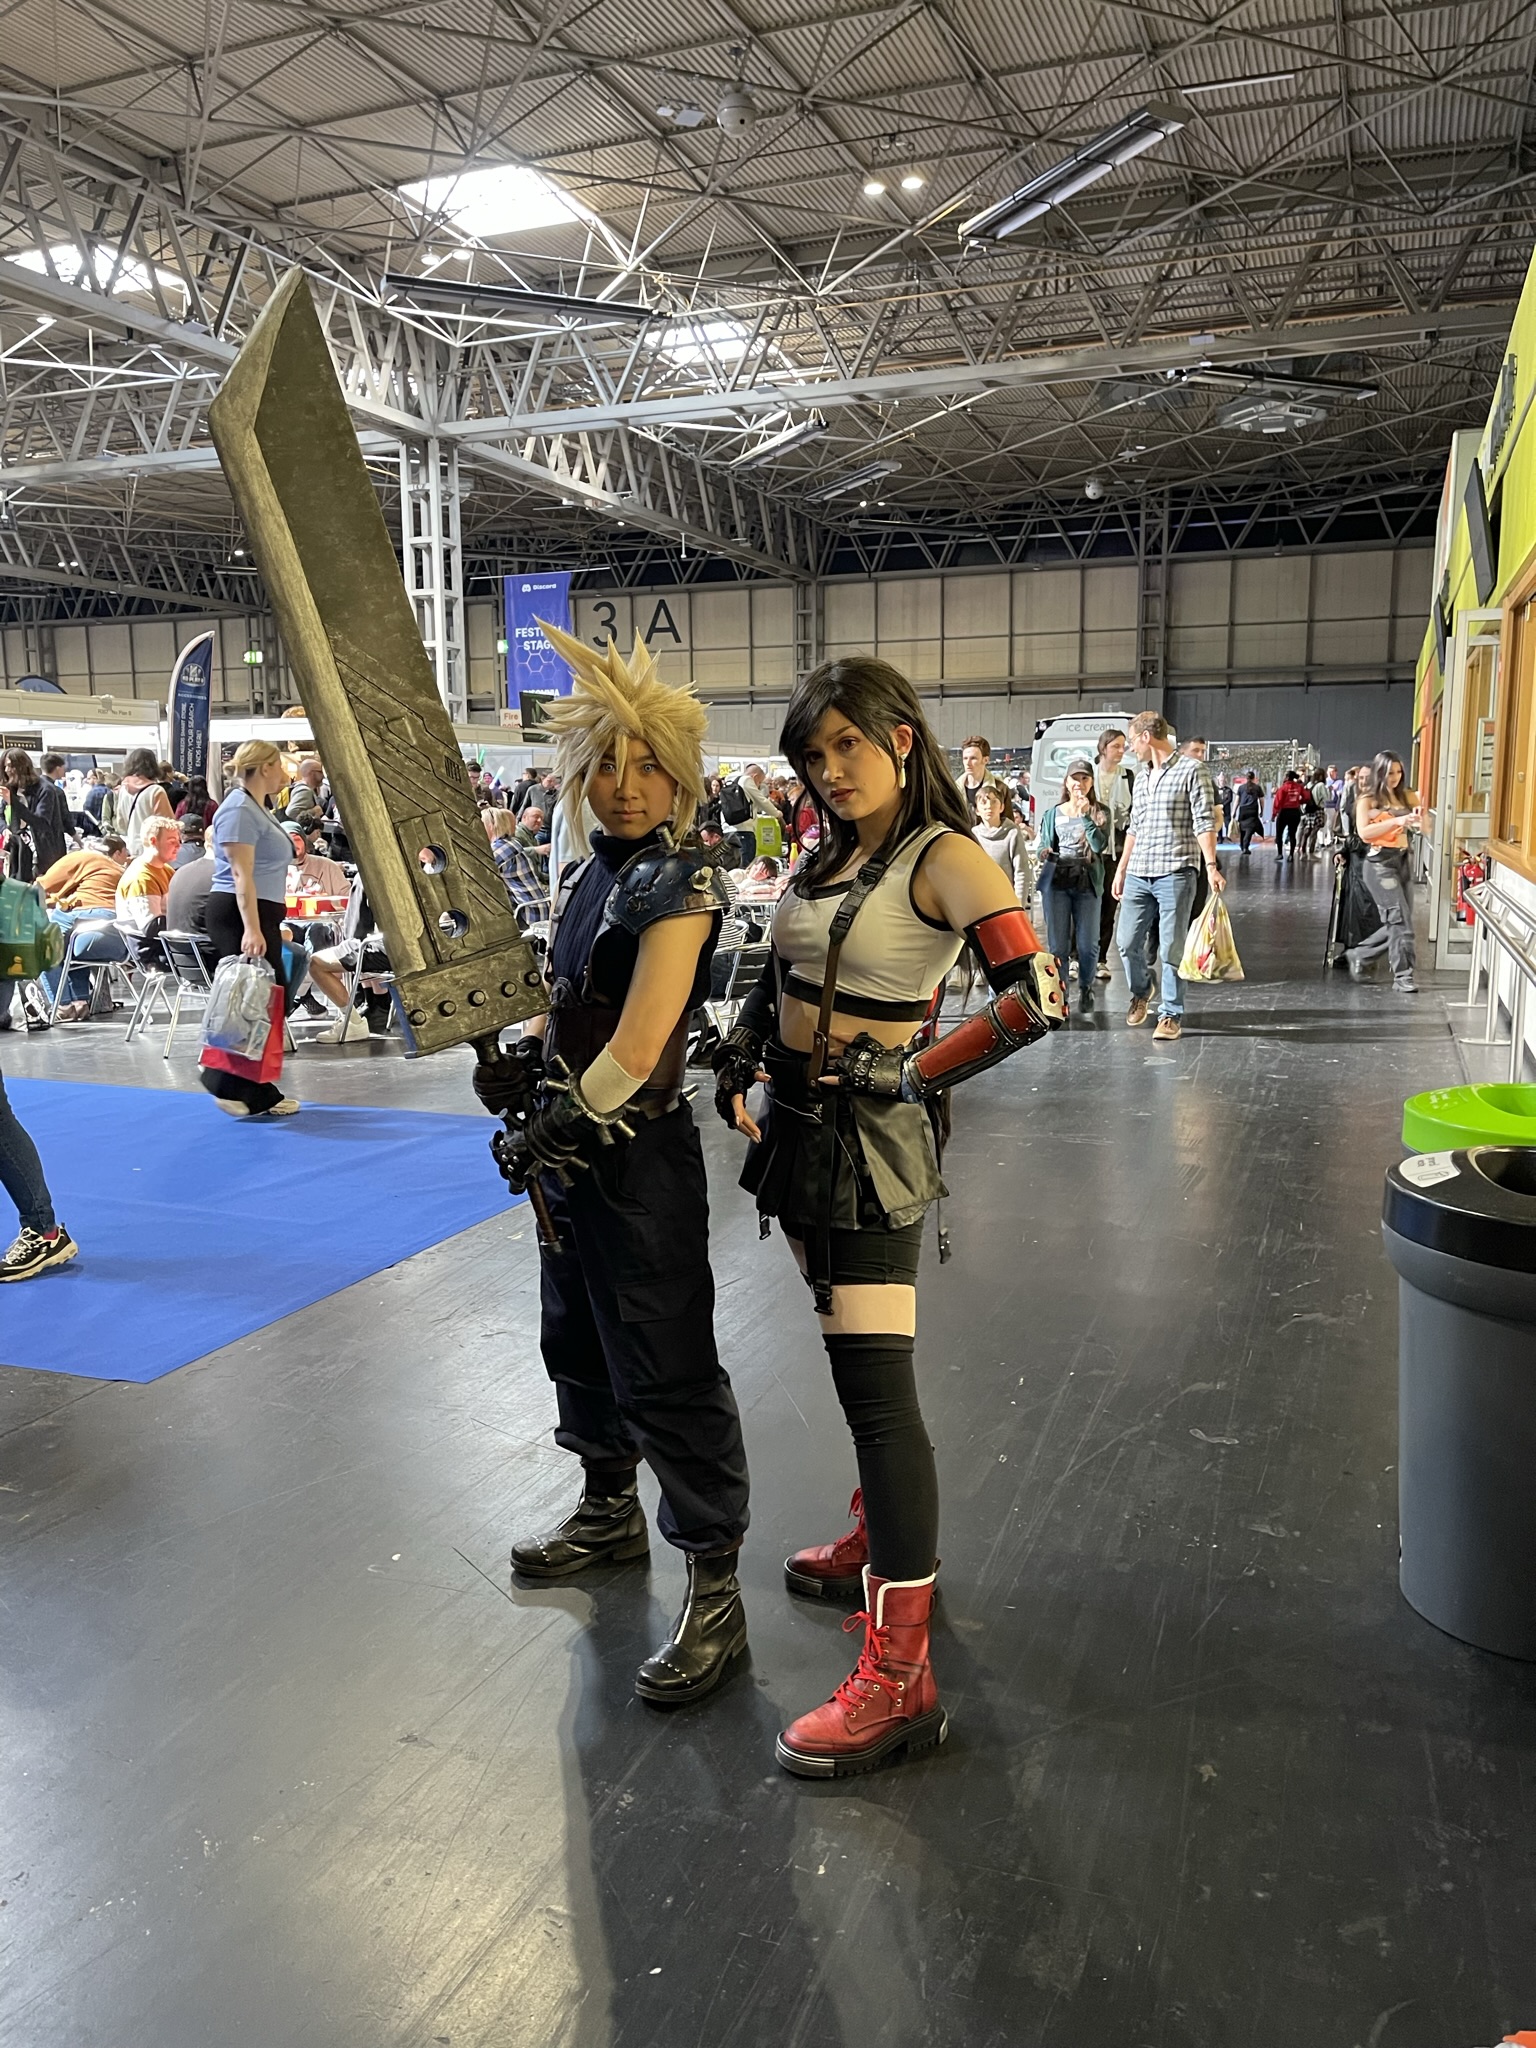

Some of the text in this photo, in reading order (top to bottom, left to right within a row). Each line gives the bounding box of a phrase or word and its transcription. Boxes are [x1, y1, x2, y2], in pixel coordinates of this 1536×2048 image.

[592, 599, 682, 648] 3 A
[1066, 722, 1115, 732] ice cream
